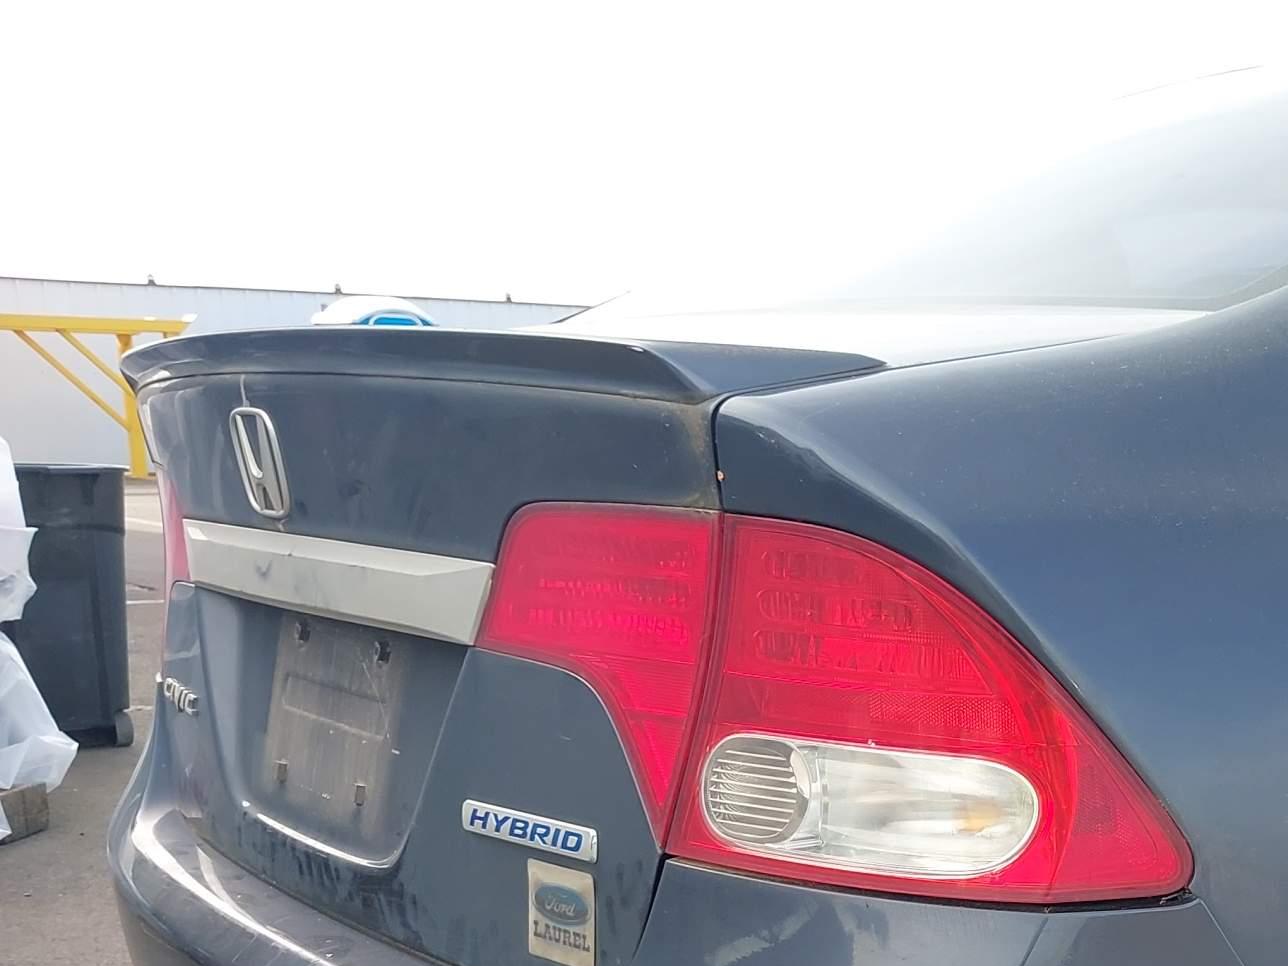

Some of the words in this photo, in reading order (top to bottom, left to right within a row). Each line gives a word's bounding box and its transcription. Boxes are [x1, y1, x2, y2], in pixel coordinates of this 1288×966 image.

[164, 677, 198, 715] CIVIC
[469, 808, 583, 852] HYBRID
[544, 892, 577, 916] Ford
[533, 919, 591, 952] LAUREL
